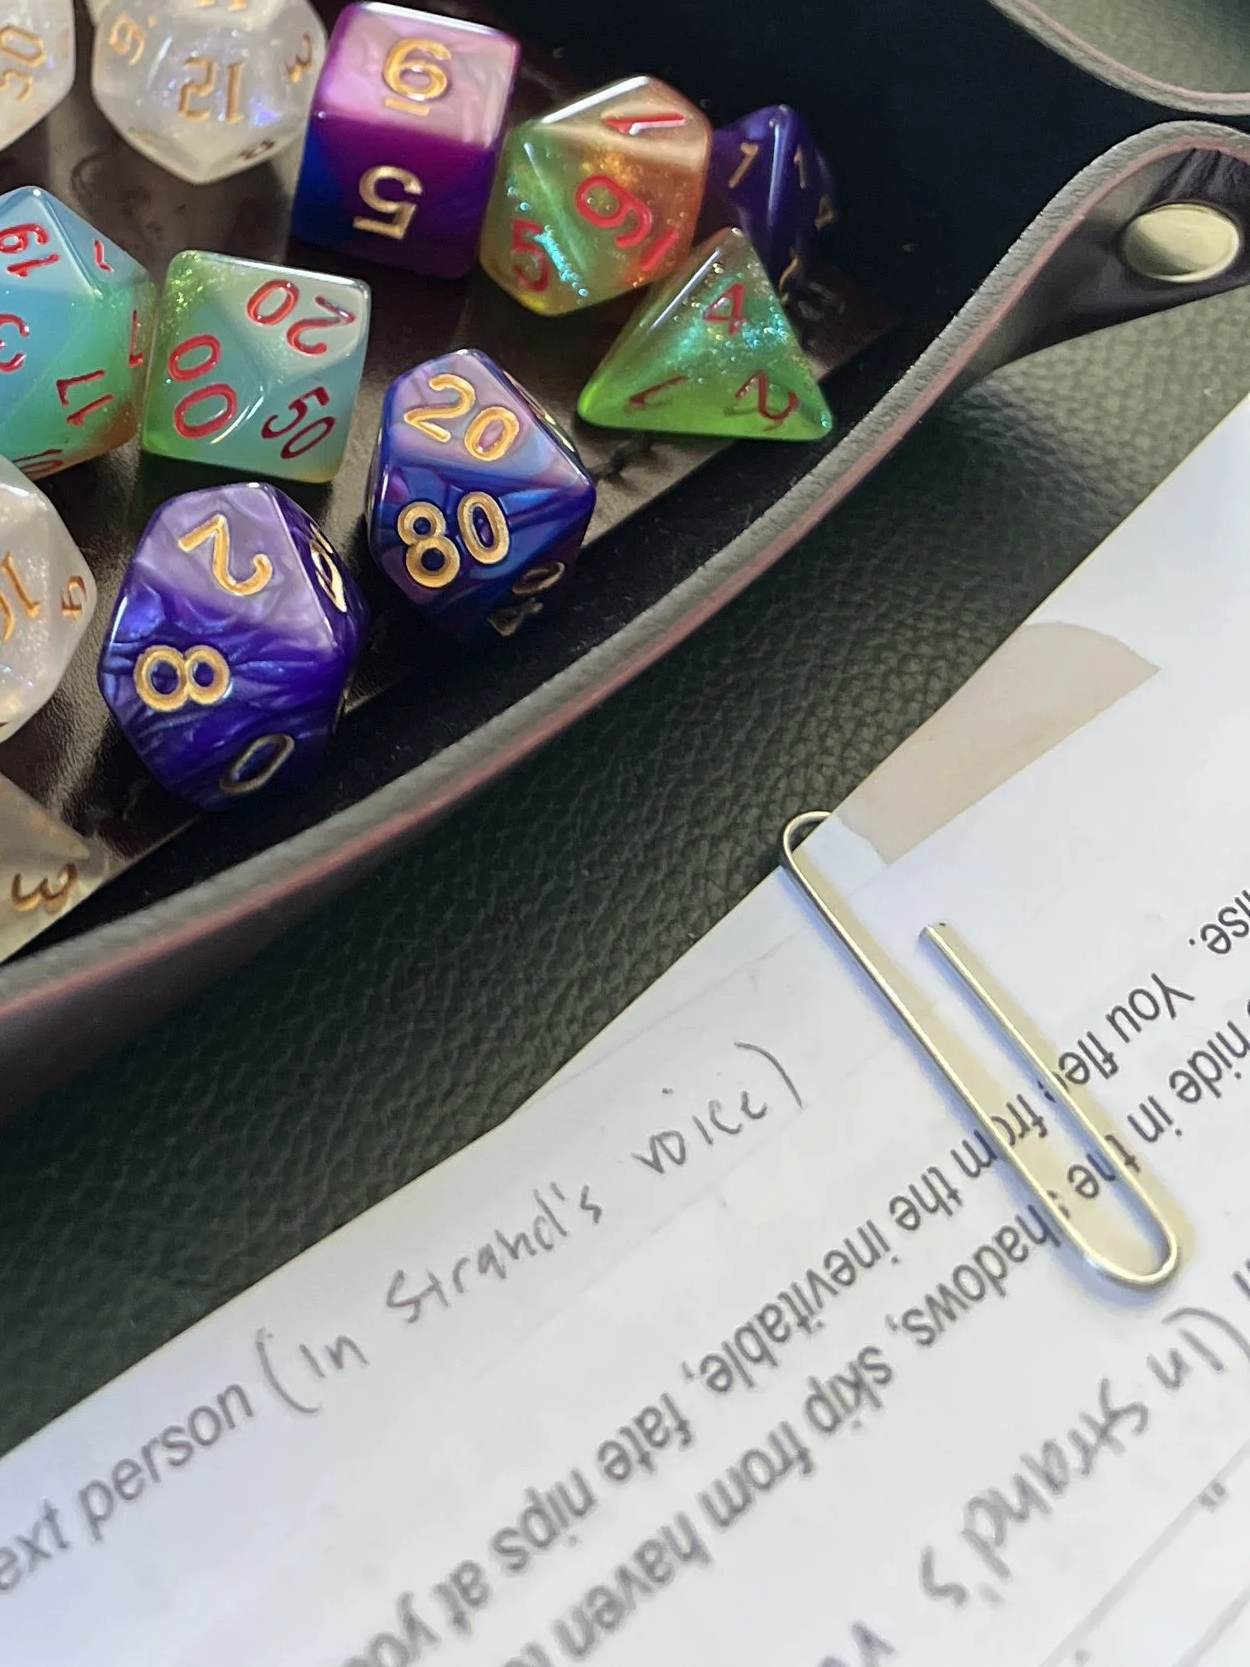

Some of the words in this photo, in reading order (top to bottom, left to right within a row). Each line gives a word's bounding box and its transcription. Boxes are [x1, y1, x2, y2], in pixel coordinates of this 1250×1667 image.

[352, 165, 424, 240] 5
[511, 218, 550, 293] 5
[247, 278, 356, 357] 20
[703, 283, 748, 336] 4
[55, 369, 115, 428] 17
[168, 333, 238, 440] 00
[260, 385, 337, 460] 50
[403, 372, 520, 462] 20
[734, 369, 801, 432] 2
[176, 513, 275, 597] 2
[397, 490, 511, 589] 80
[132, 644, 231, 712] 8
[218, 733, 296, 797] 0
[10, 862, 79, 915] 3
[1105, 972, 1196, 1044] You
[1126, 1094, 1183, 1144] in
[386, 1182, 603, 1324] Strand's
[631, 1041, 803, 1175] voice)
[888, 1165, 964, 1232] the
[681, 1219, 903, 1395] inevitable,
[803, 1344, 894, 1437] skip
[77, 1381, 256, 1544] person
[596, 1391, 695, 1483] fate
[697, 1419, 815, 1528] from
[488, 1468, 599, 1575] nips
[432, 1559, 492, 1637] at
[551, 1510, 713, 1661] haven
[342, 1589, 442, 1667] yo
